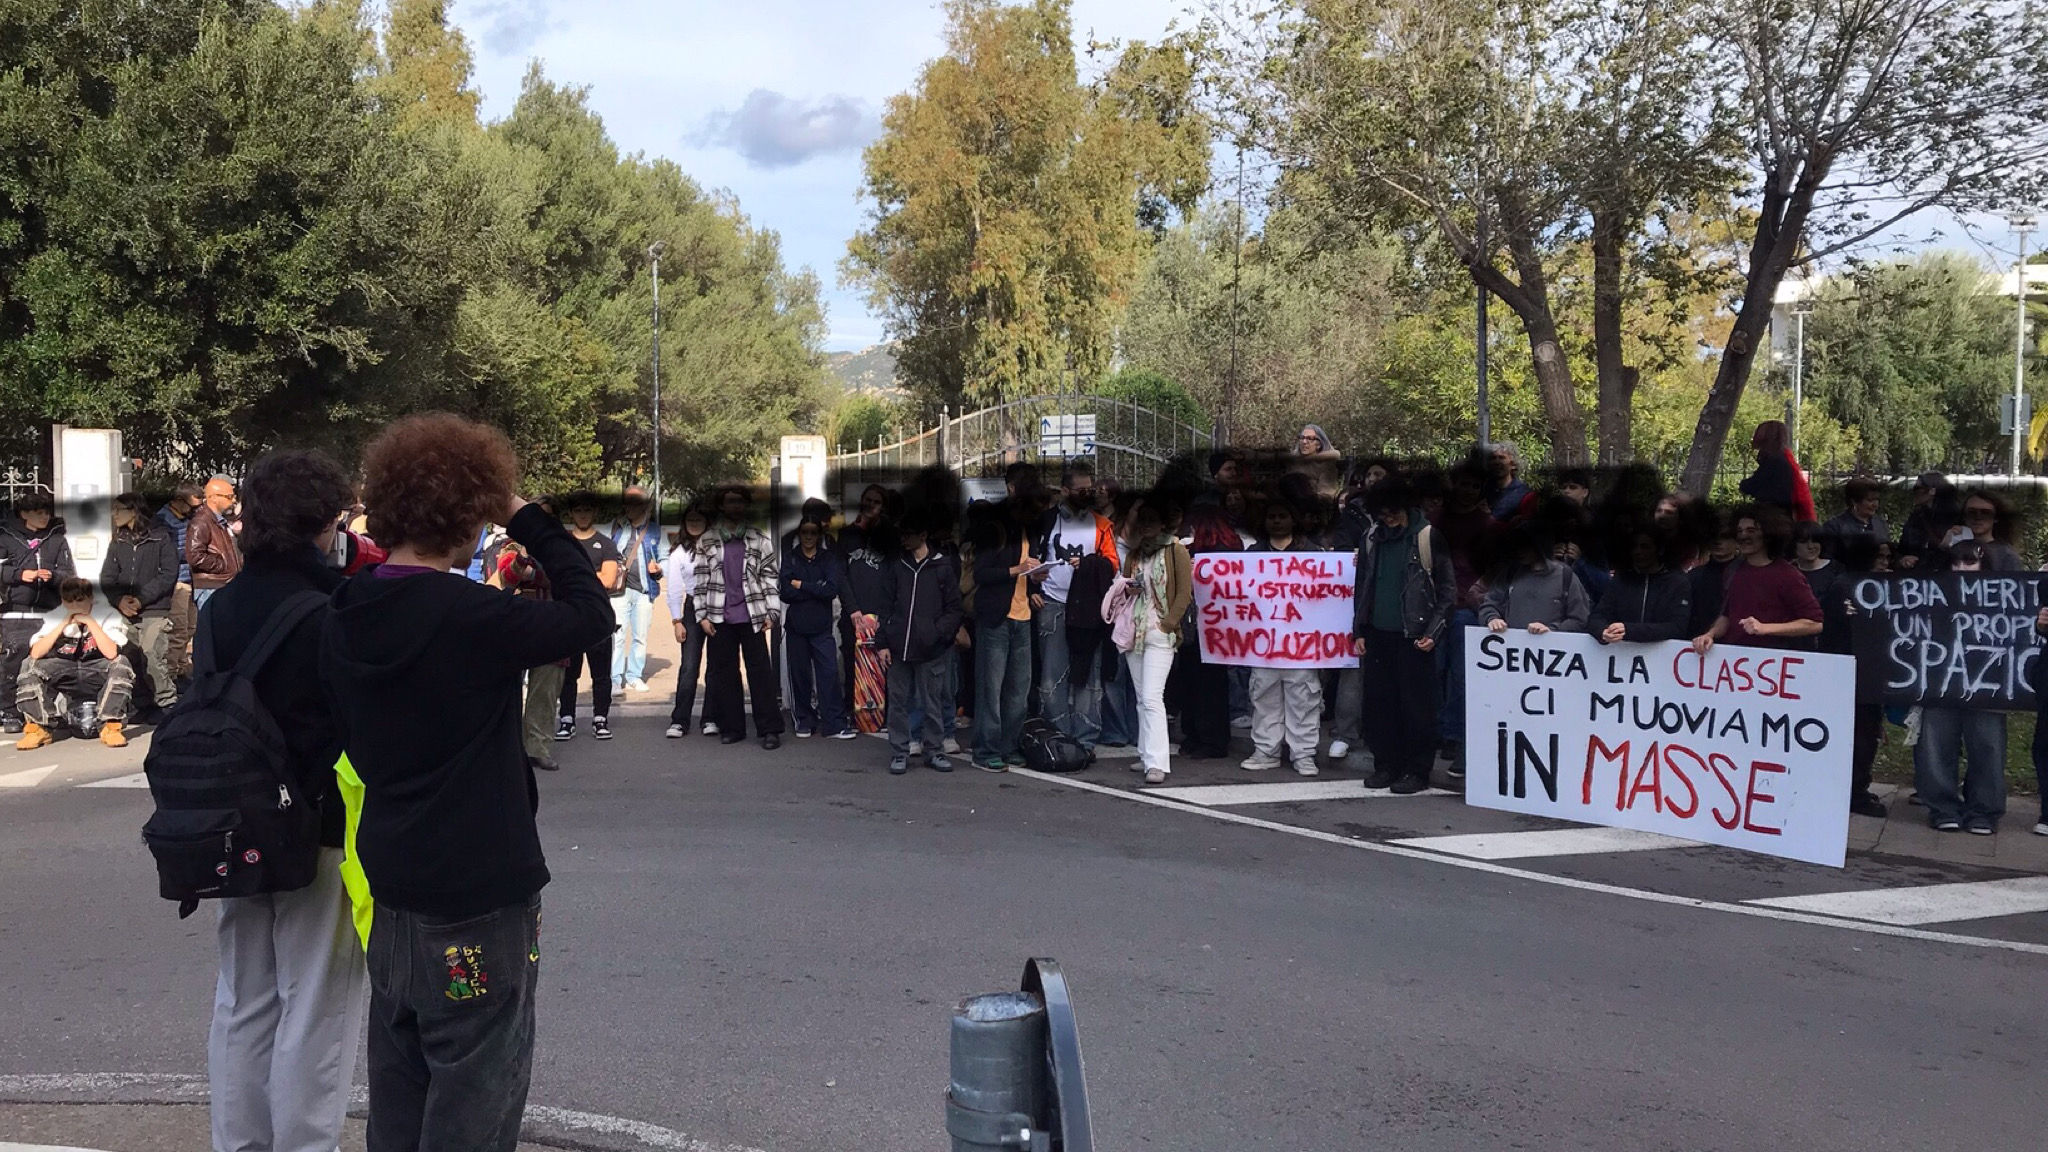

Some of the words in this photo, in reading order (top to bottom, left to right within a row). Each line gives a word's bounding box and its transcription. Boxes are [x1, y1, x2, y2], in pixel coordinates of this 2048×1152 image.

[1194, 558, 1244, 584] CON
[1269, 556, 1343, 580] TAGLI
[1855, 578, 1948, 611] OLBIA
[1960, 575, 2039, 610] MERIT
[1203, 602, 1228, 625] SI
[1235, 603, 1263, 622] FA
[1269, 602, 1303, 623] LA
[1893, 612, 1933, 640] UN
[1477, 634, 1588, 680] SENZA
[1608, 655, 1650, 684] LA
[1673, 647, 1805, 700] CLASSE
[1520, 686, 1555, 715] CI
[1590, 692, 1830, 752] MUOVIAMO
[1582, 734, 1787, 836] MASSE
